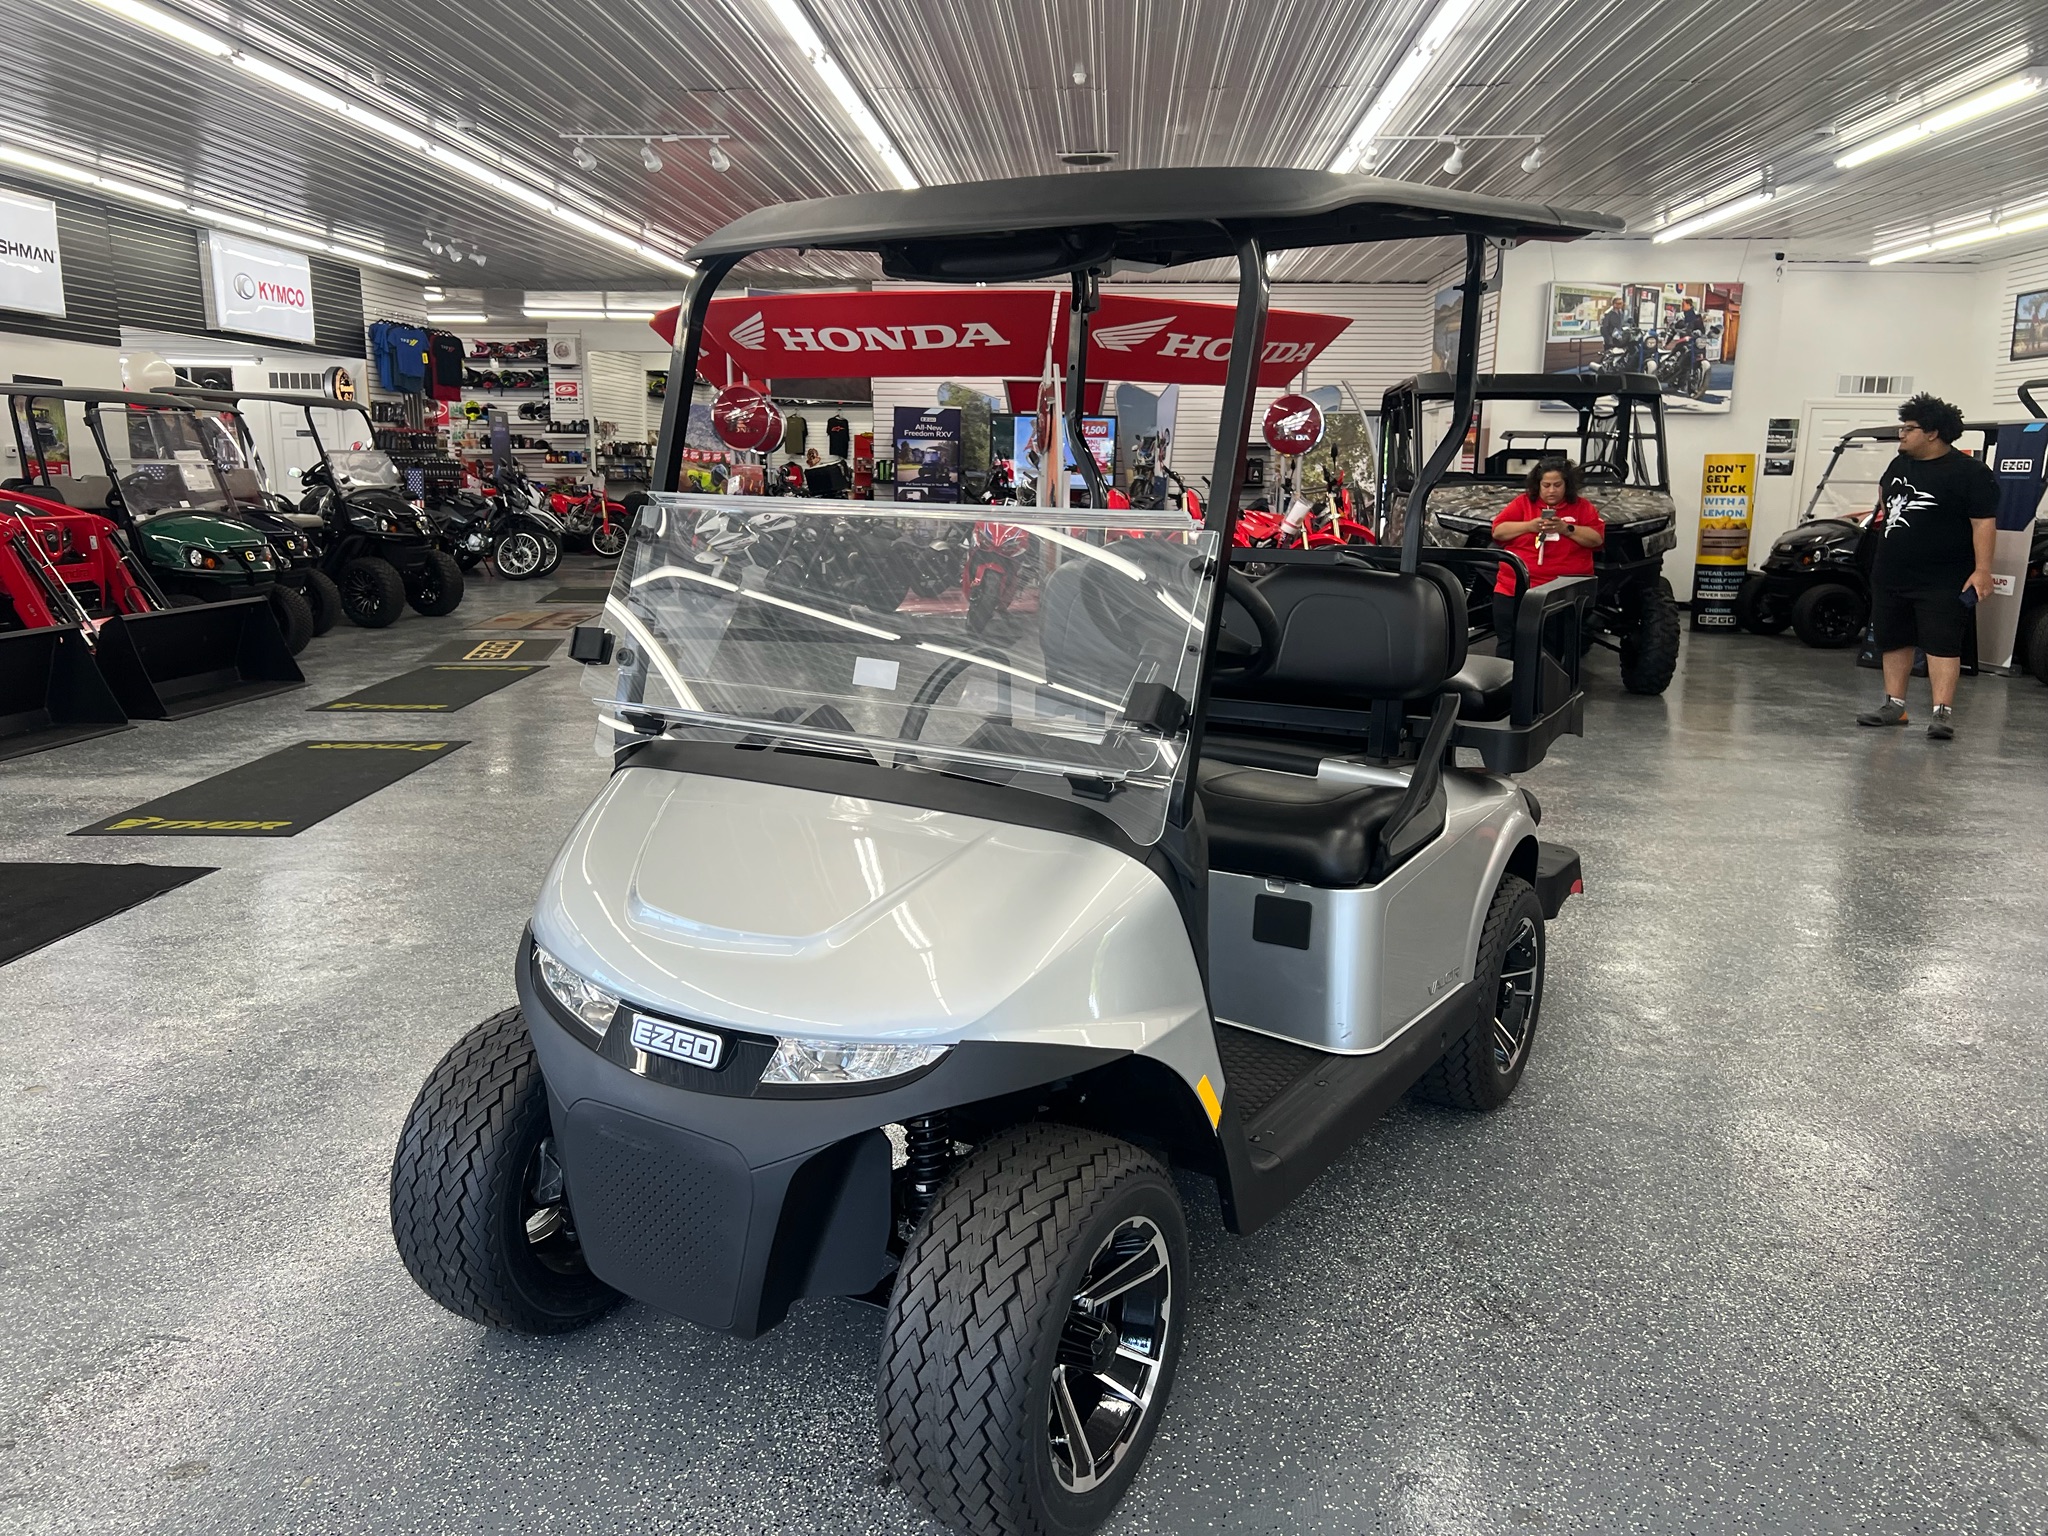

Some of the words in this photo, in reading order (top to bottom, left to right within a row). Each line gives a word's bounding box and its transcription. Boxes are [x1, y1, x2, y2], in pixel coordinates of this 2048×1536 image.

[258, 281, 305, 307] KYMCO
[772, 322, 1011, 352] HONDA
[1156, 332, 1316, 364] HODA
[1707, 465, 1747, 473] DON'T
[2002, 461, 2031, 471] EZGO
[1706, 475, 1730, 483] GET
[1706, 485, 1746, 493] STUCK
[1704, 497, 1736, 506] WITH
[1703, 509, 1745, 517] LEMON.
[148, 820, 293, 830] THOR
[634, 1020, 715, 1062] EZGO
